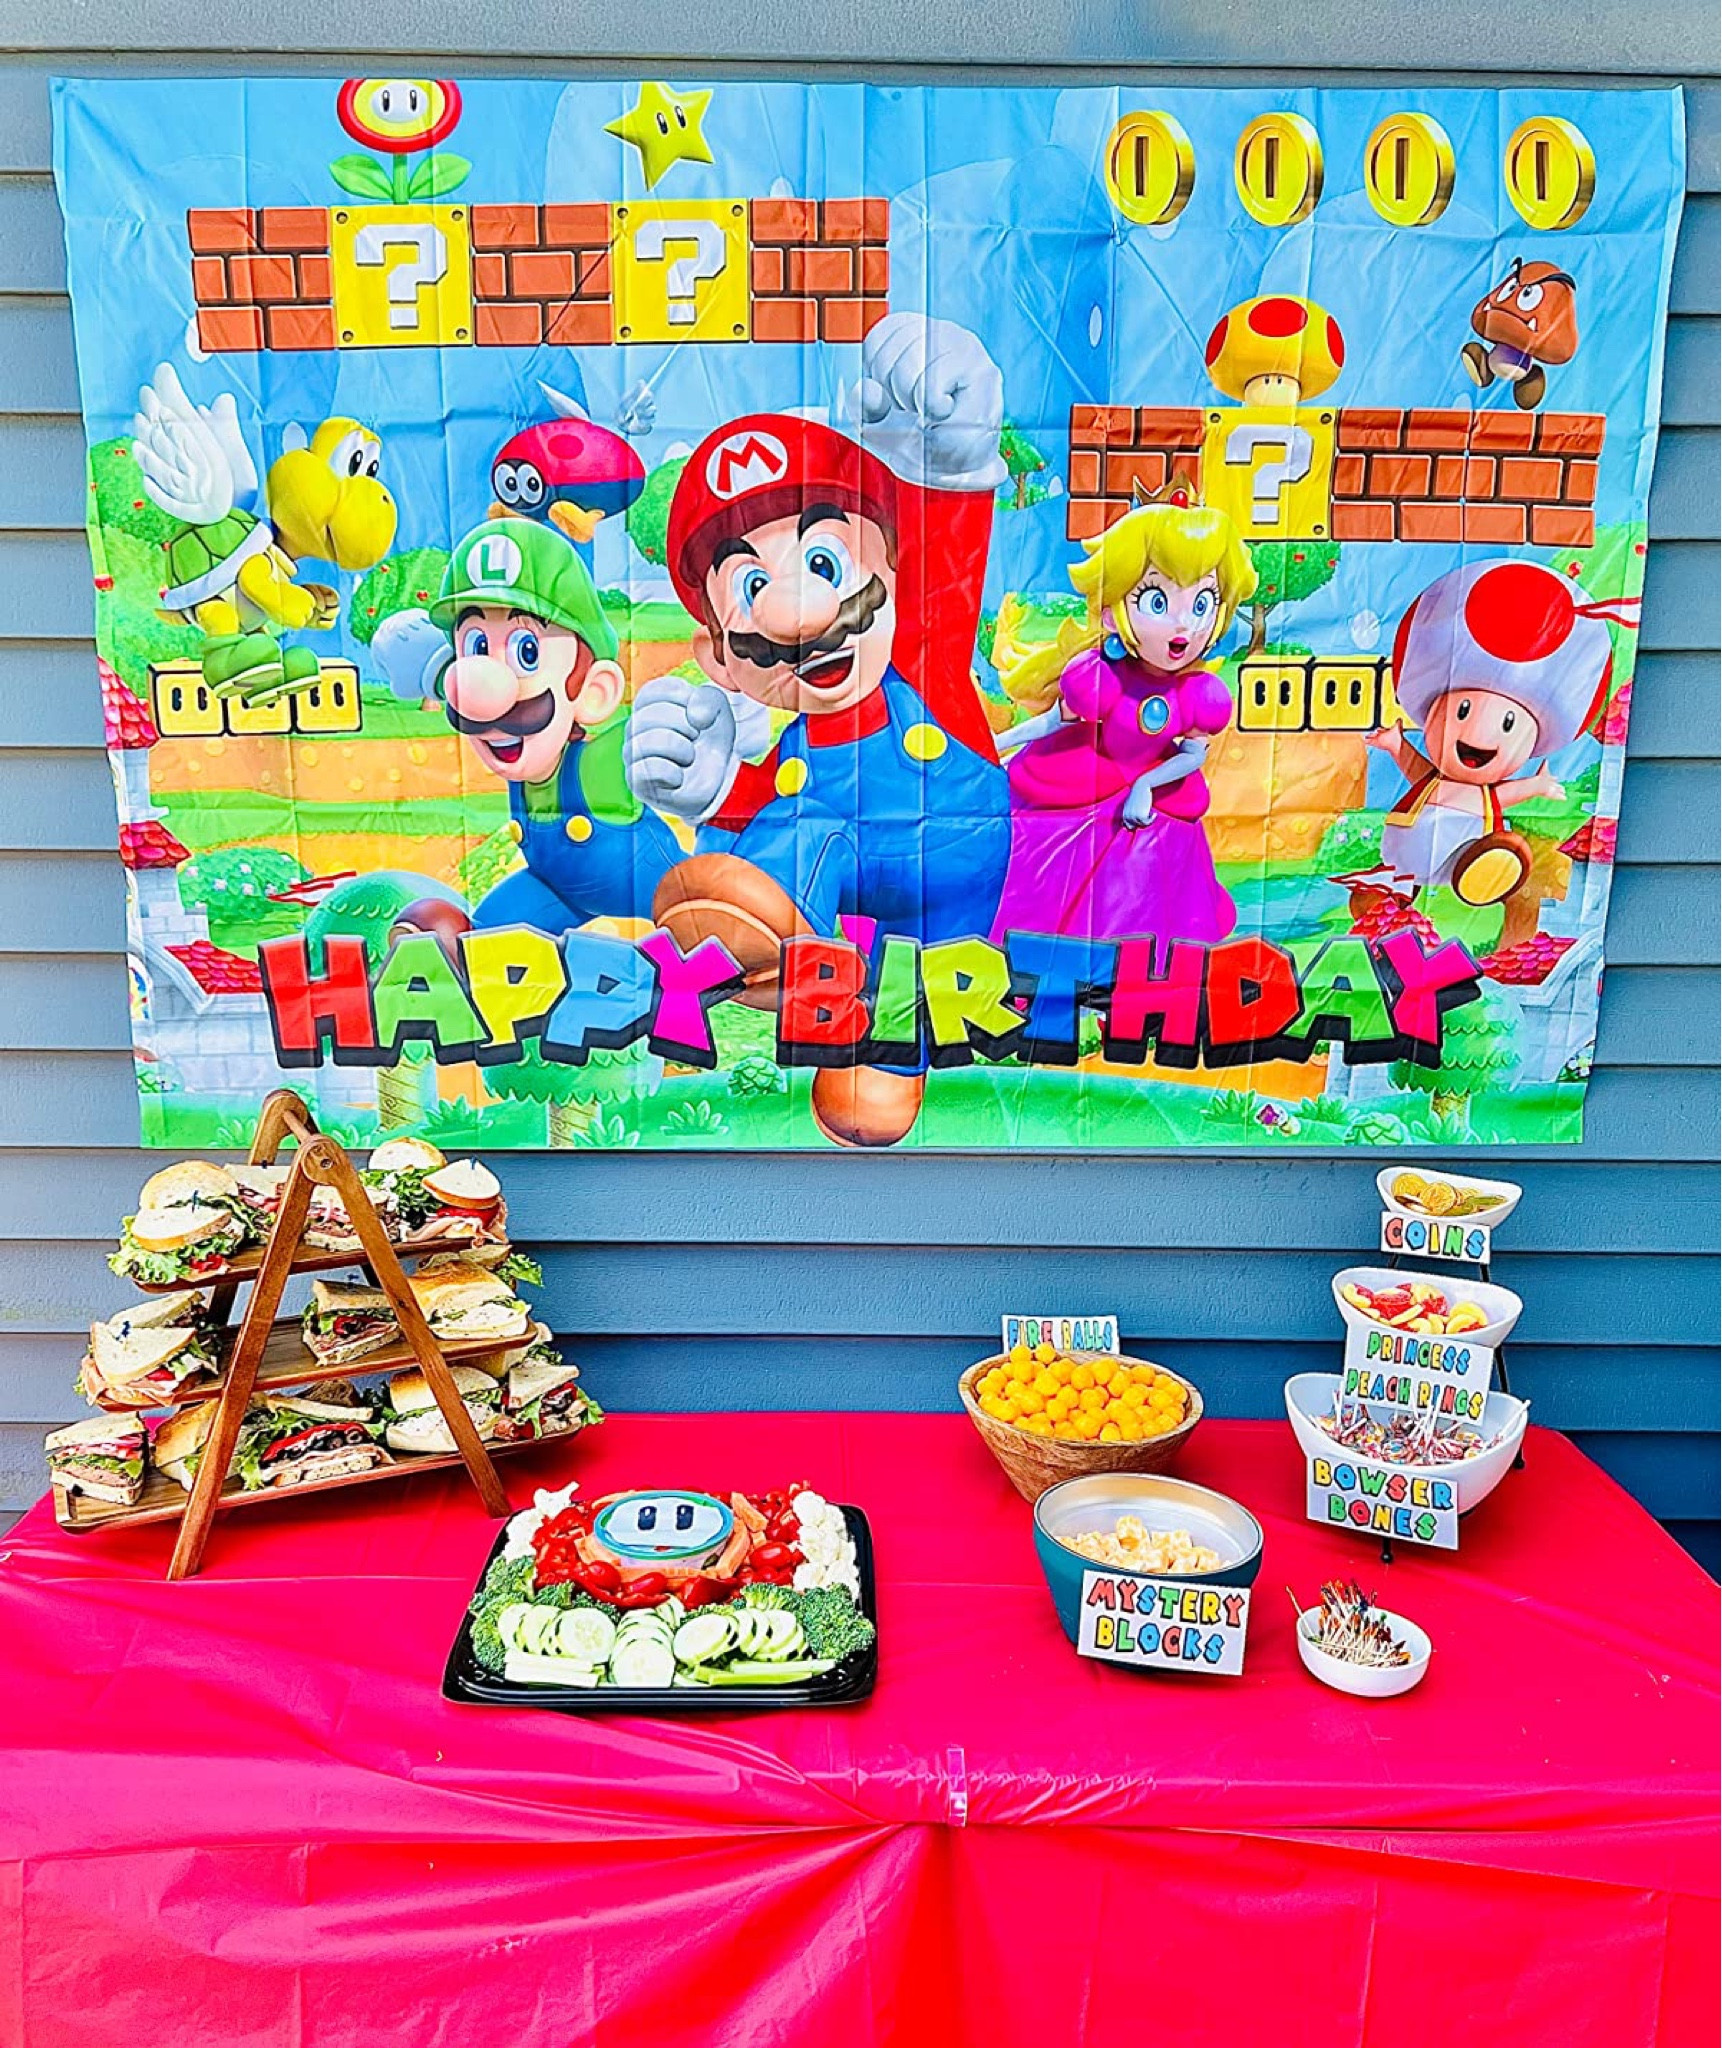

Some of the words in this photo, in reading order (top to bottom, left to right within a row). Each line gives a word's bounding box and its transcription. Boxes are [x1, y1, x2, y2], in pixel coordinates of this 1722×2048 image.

[716, 435, 783, 493] M
[481, 544, 507, 581] L
[258, 923, 746, 1070] HAPPY
[776, 926, 1486, 1071] BIRTHDAY
[1384, 1217, 1487, 1260] COINS
[1007, 1319, 1055, 1351] FIRE
[1061, 1319, 1114, 1351] BALLS
[1366, 1331, 1471, 1376] PRINCESS
[1344, 1368, 1412, 1405] PEACH
[1313, 1457, 1454, 1511] BOWSER
[1328, 1493, 1438, 1541] BONES
[1086, 1578, 1245, 1628] MYSTERY
[1094, 1615, 1225, 1664] BLOCKS
